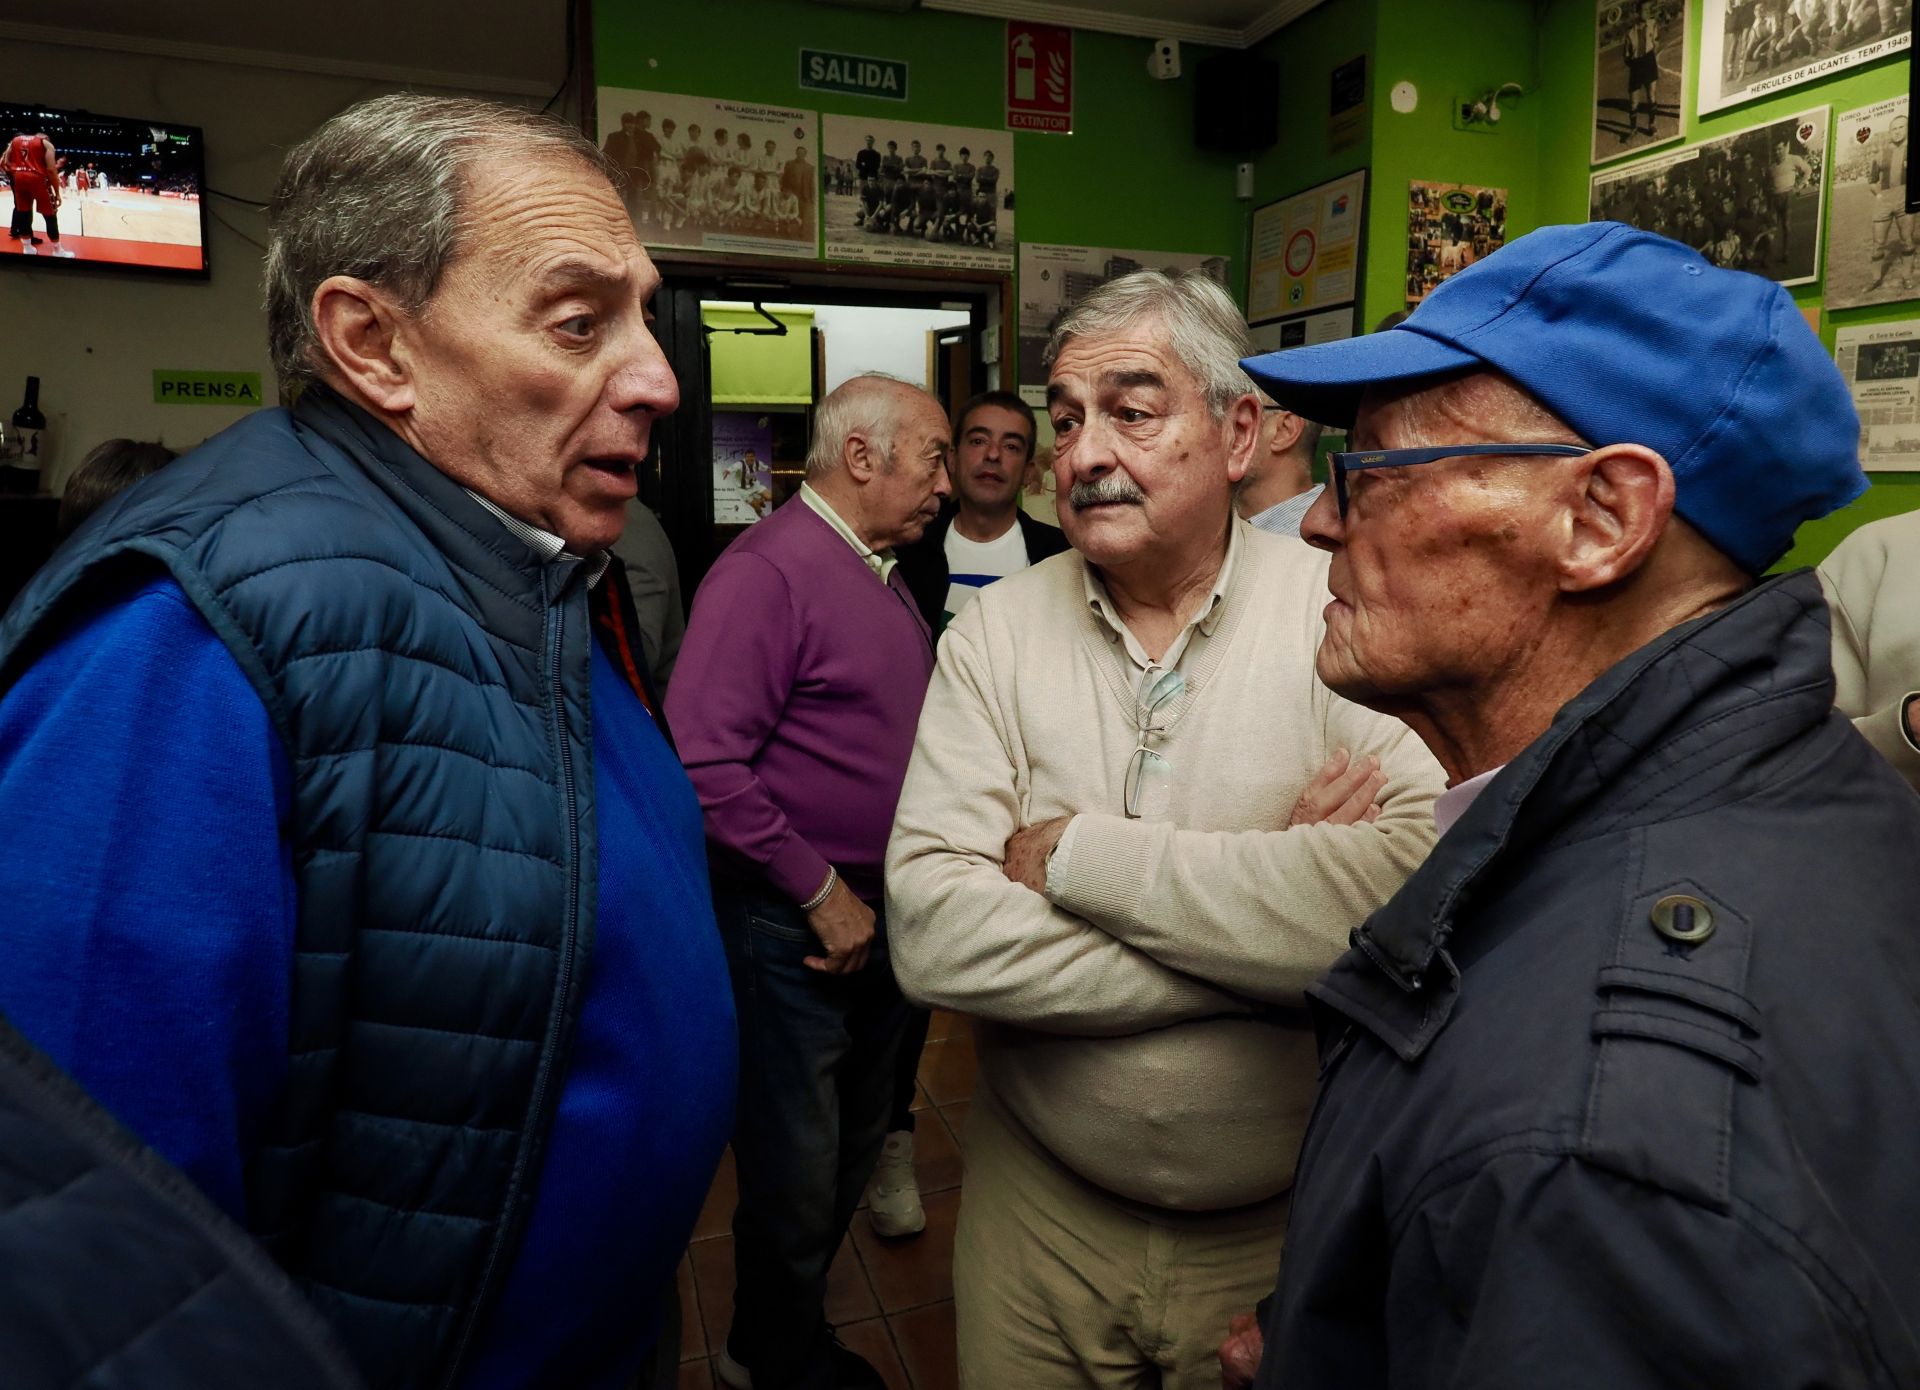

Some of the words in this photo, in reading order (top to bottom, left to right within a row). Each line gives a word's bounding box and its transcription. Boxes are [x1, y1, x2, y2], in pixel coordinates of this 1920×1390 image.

[1794, 70, 1805, 80] DE
[1807, 56, 1850, 76] ALICANTE
[1857, 45, 1884, 60] TEMP.
[810, 56, 897, 91] SALIDA
[724, 105, 767, 116] VALLADOLID
[767, 110, 804, 120] PROMESAS
[1868, 102, 1896, 114] LEVANTE
[1012, 115, 1066, 129] EXTINTOR
[161, 381, 253, 398] PRENSA
